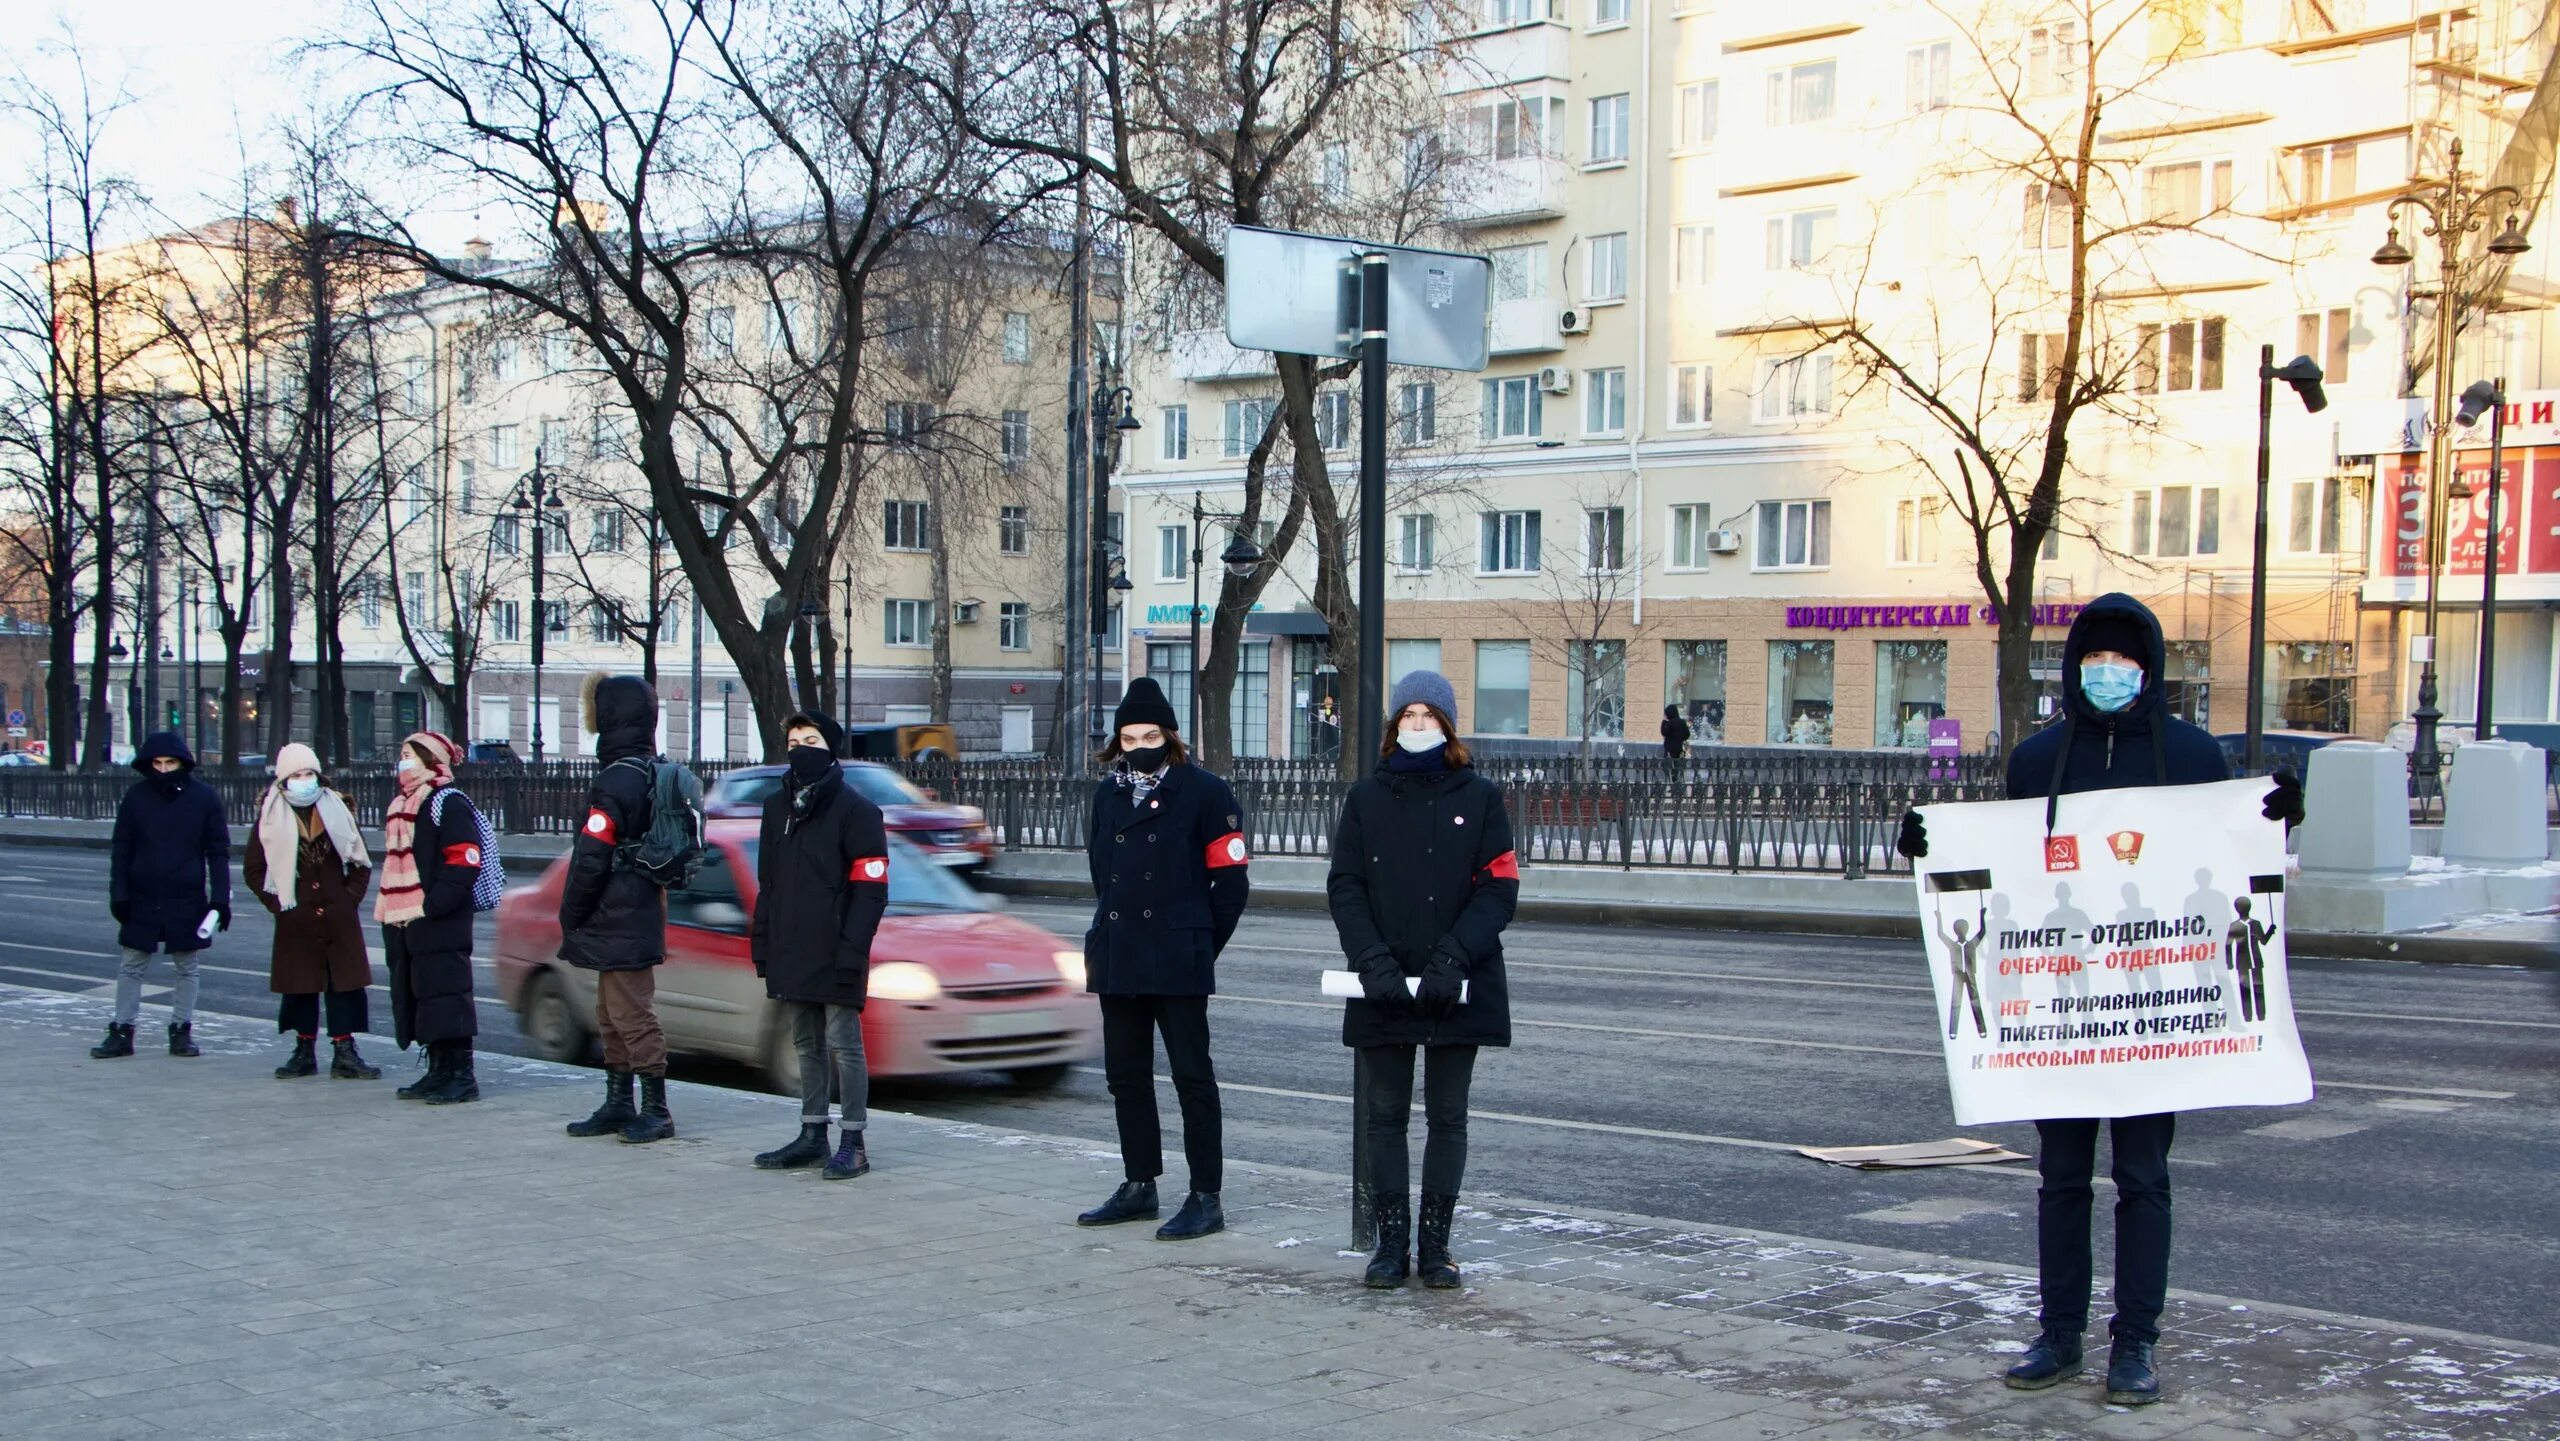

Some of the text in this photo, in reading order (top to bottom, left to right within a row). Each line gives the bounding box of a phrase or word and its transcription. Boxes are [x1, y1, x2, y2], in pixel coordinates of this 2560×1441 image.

[1786, 604, 1972, 631] КОНДИТЕРСКАЯ
[2050, 861, 2075, 870] КПРФ
[2000, 927, 2067, 950] ПИКЕТ
[2090, 914, 2212, 948] ОТДЕЛЬНО,
[1999, 954, 2083, 977] ОЧЕРЕДЬ
[2105, 941, 2217, 972] ОТДЕЛЬНО!
[2000, 1000, 2031, 1017] НЕТ
[2051, 985, 2222, 1014] ПРИРАВНИВАНИЮ
[2000, 1007, 2228, 1043] ПИКЕТНЫНЫХ ОЧЕРЕДЕЙ
[1971, 1035, 2263, 1070] К МАССОВЫМ МЕРОПРИЯТИЯМ!
